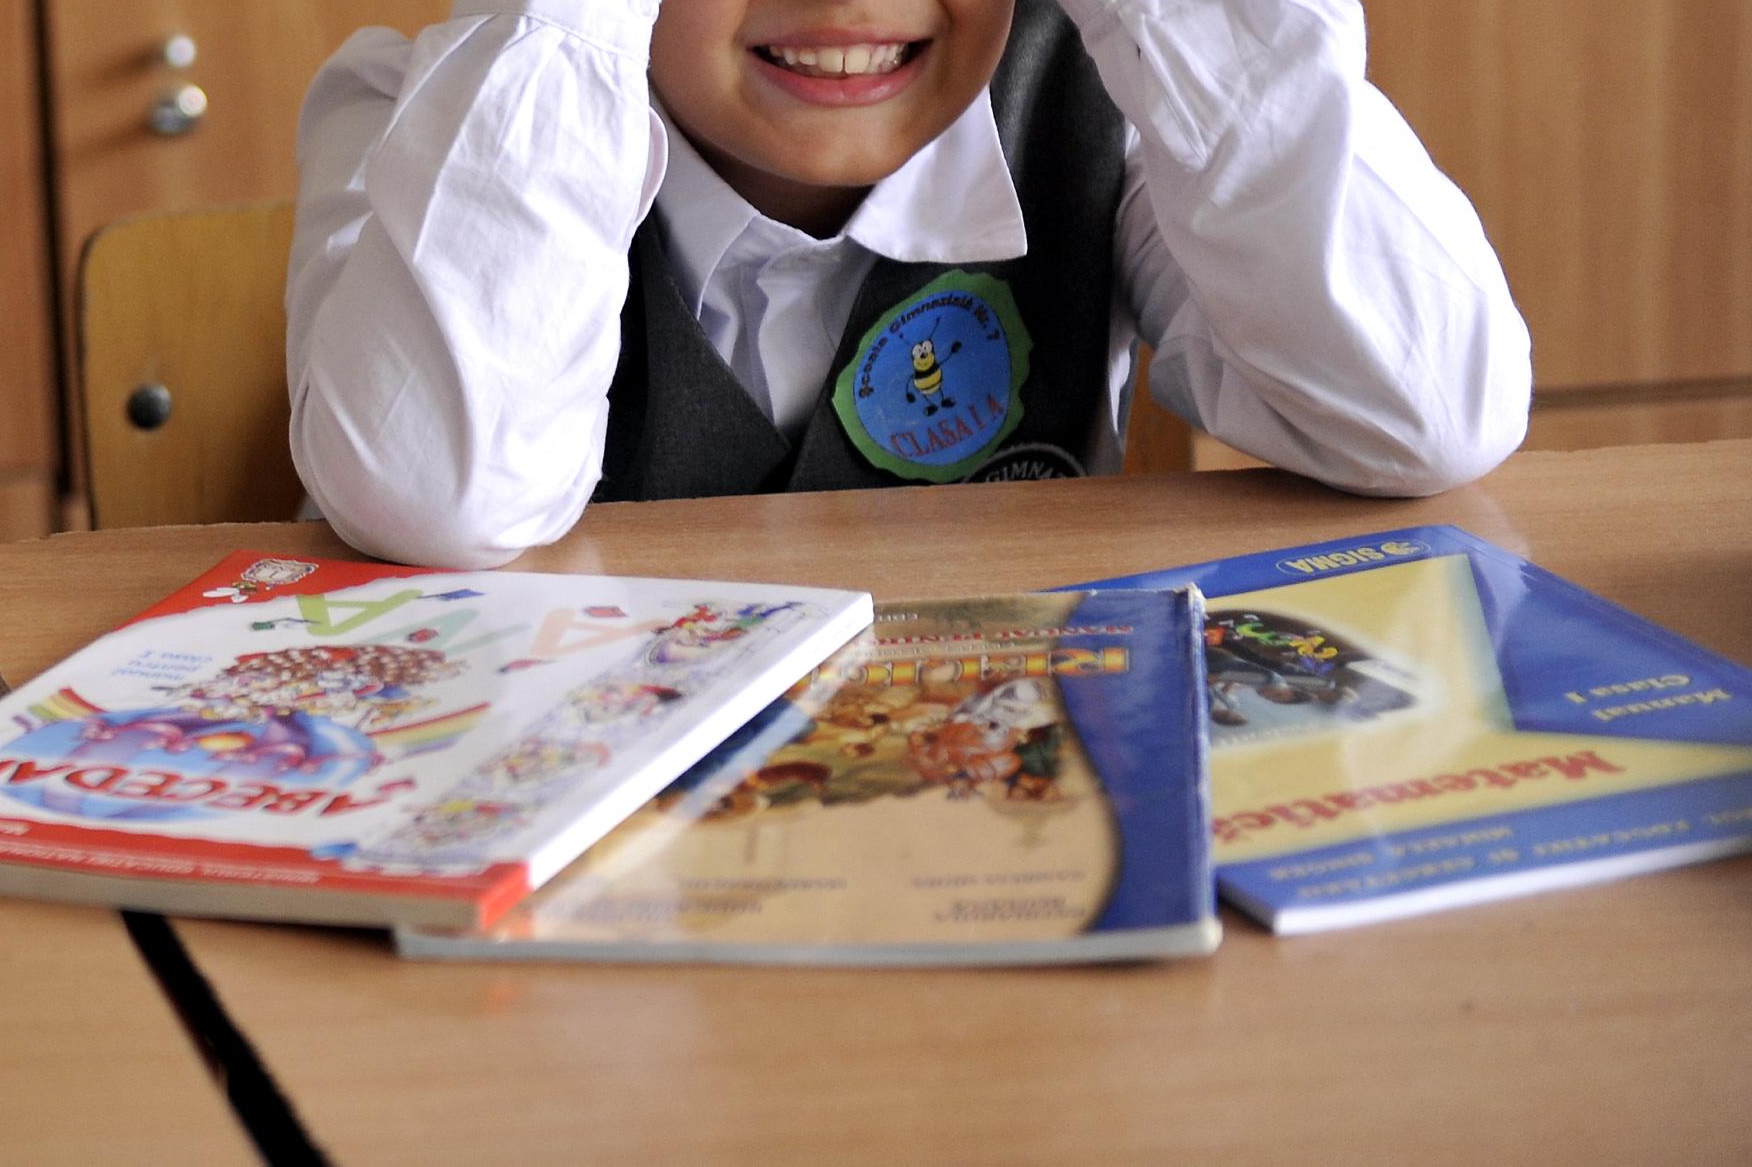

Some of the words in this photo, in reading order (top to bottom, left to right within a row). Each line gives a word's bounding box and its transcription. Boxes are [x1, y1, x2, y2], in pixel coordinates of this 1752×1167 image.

[889, 415, 973, 459] CLASA
[967, 403, 986, 431] I
[986, 392, 1006, 424] A
[1284, 546, 1386, 574] SIGMA
[994, 625, 1135, 641] MANUAL
[1583, 672, 1694, 698] Clasa
[1593, 686, 1734, 722] Manual
